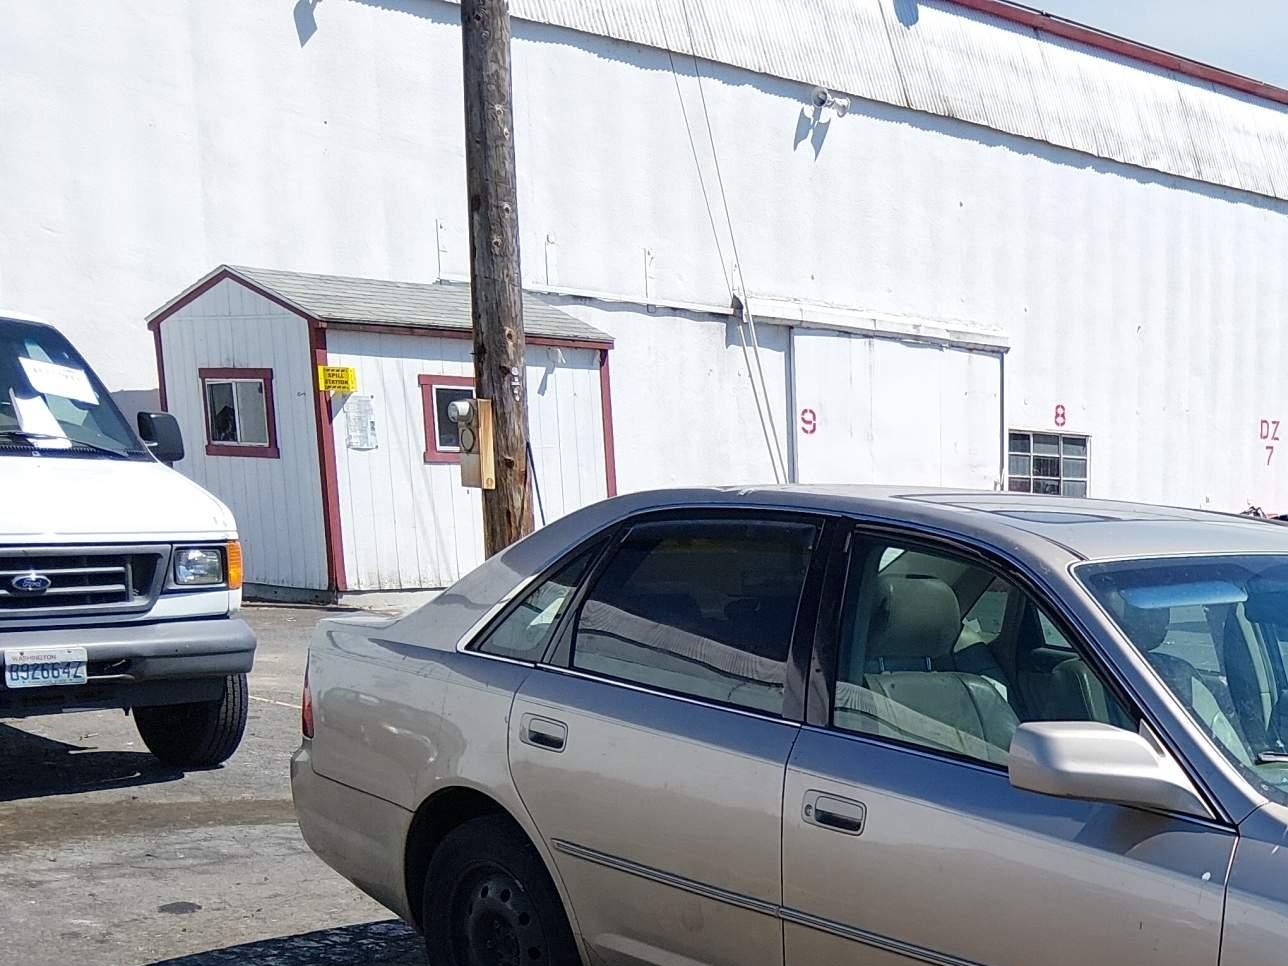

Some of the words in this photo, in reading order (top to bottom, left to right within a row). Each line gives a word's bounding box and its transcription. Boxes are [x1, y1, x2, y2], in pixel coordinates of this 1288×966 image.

[801, 408, 816, 434] 9
[1055, 404, 1066, 427] 8
[1260, 419, 1280, 441] DZ
[1265, 446, 1275, 466] 7
